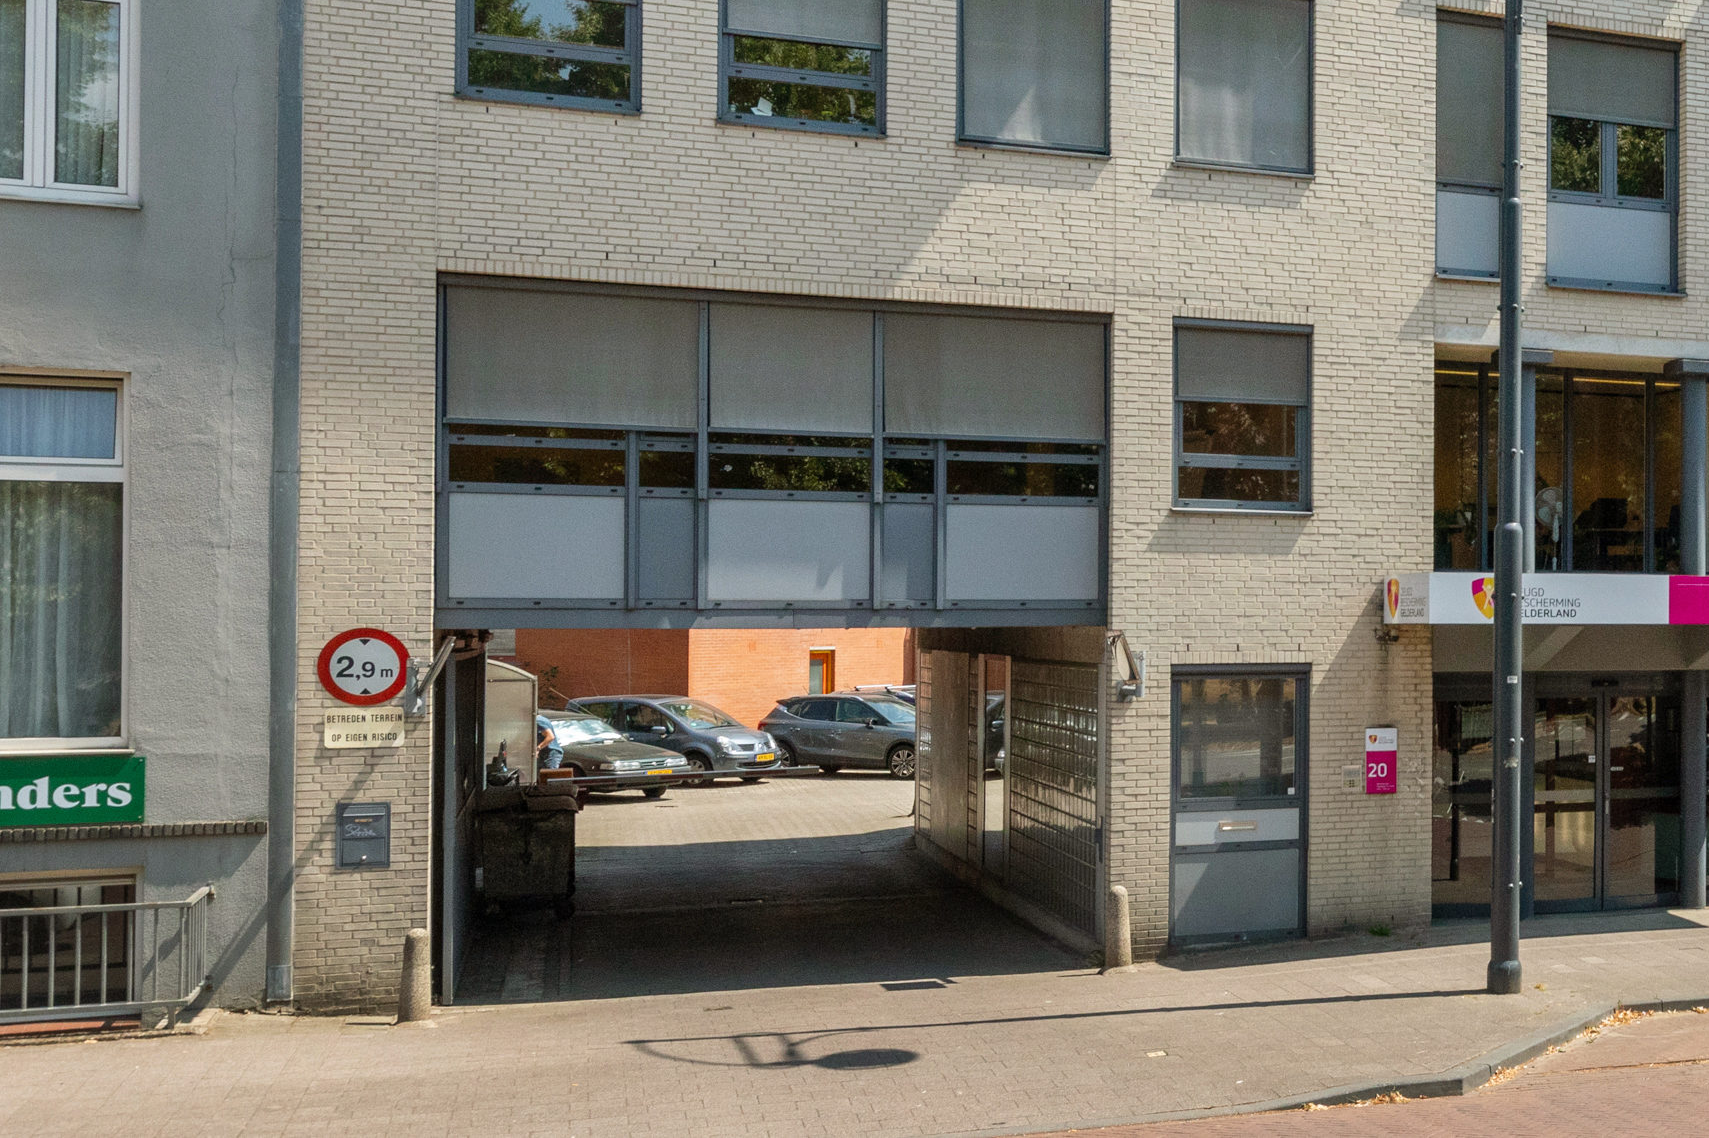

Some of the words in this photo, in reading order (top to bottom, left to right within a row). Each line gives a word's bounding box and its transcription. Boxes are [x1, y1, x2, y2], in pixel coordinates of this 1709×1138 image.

[1523, 587, 1545, 597] UGD
[1523, 598, 1581, 608] SCHERMING
[1521, 608, 1577, 618] ELDERLAND
[336, 656, 375, 681] 2,9
[380, 668, 394, 678] m
[326, 714, 366, 724] BETREDEN
[371, 713, 403, 722] TERREIN
[331, 733, 342, 742] OP
[345, 733, 368, 742] EIGEN
[371, 732, 398, 741] RISICO
[1367, 762, 1388, 778] 20
